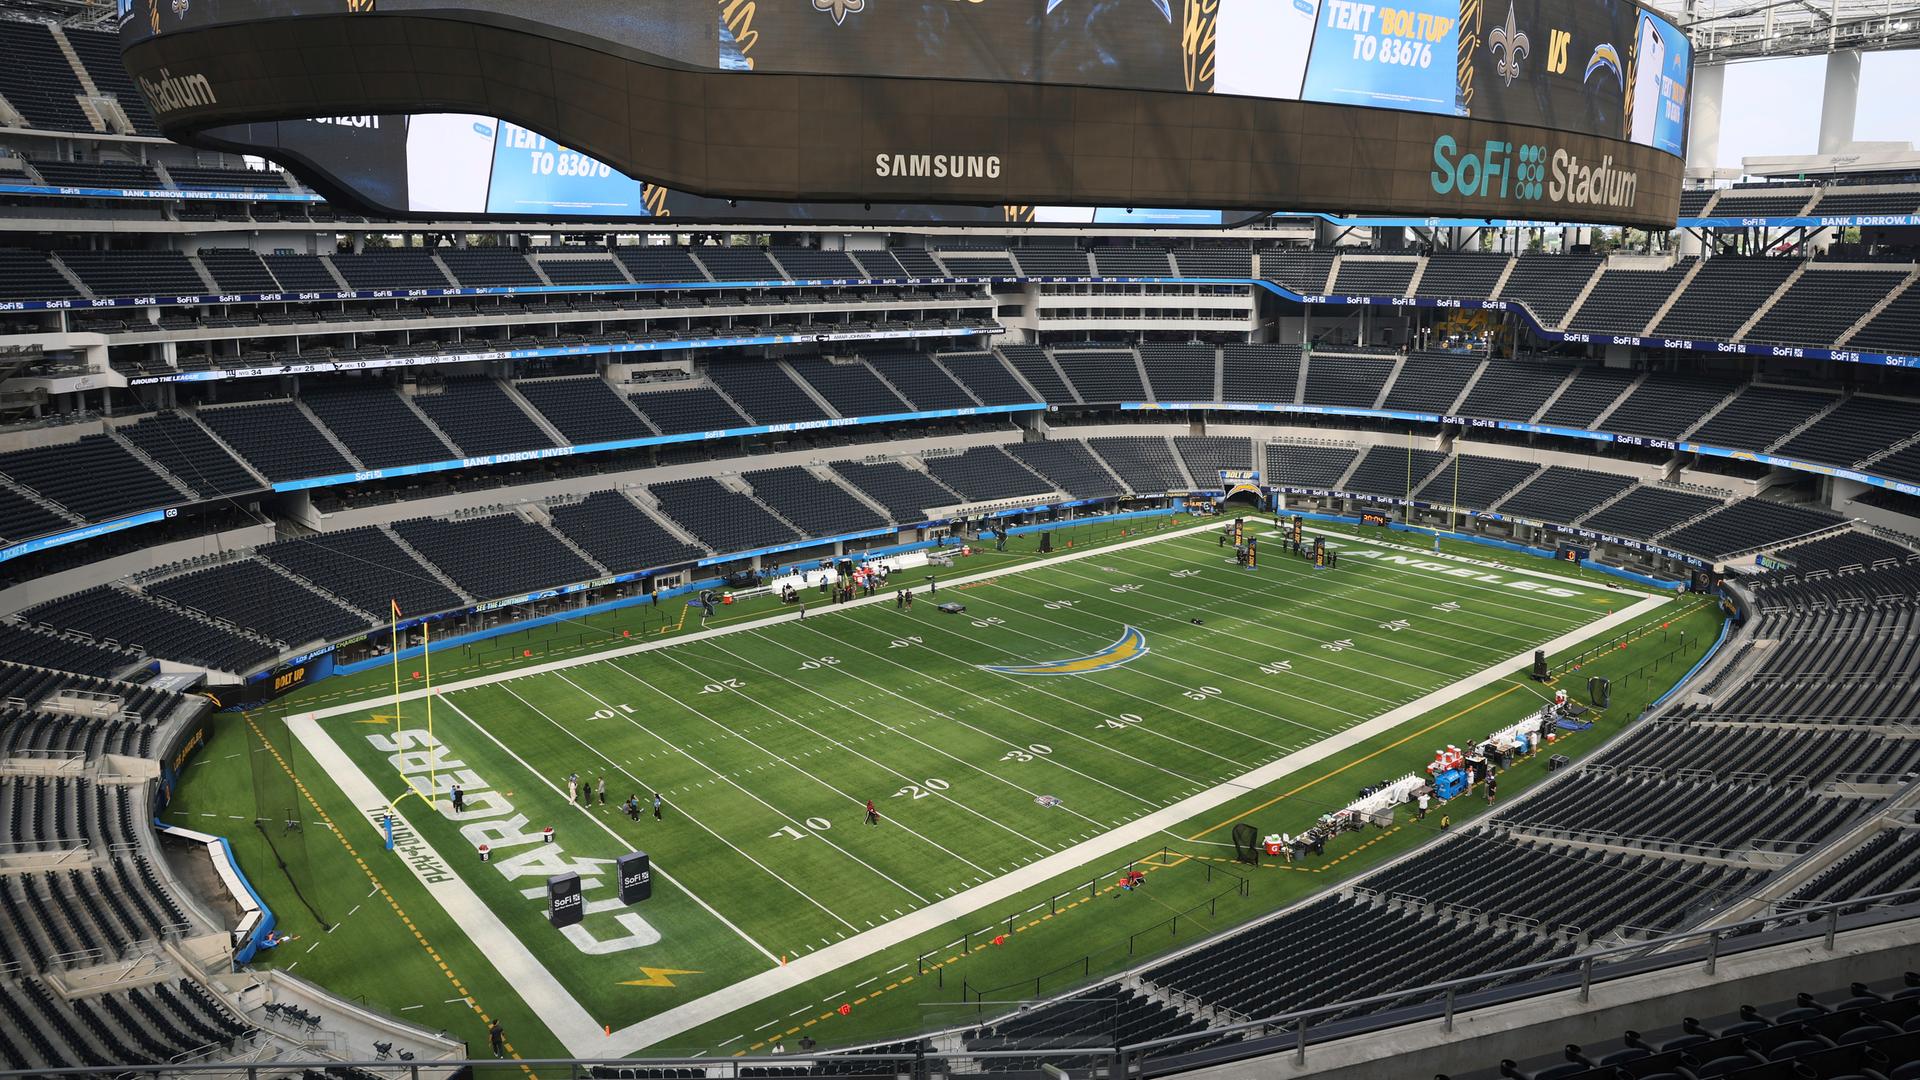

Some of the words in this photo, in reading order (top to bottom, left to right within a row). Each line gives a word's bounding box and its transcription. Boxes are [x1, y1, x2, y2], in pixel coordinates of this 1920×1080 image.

[1327, 0, 1375, 32] TEXT
[1353, 34, 1375, 60] TO
[1380, 36, 1432, 68] 83676
[1547, 30, 1570, 74] VS
[139, 68, 216, 114] Stadium
[531, 152, 554, 175] TO
[876, 154, 1000, 179] SAMSUNG
[1431, 135, 1512, 199] SoFi
[1550, 148, 1637, 208] Stadium
[1822, 217, 1852, 225] BANK.
[1856, 216, 1906, 225] BORROW.
[1564, 334, 1580, 343] SoFi
[1613, 337, 1630, 346] SoFi
[1664, 339, 1683, 349] SoFi
[1718, 343, 1736, 353] SoFi
[1773, 347, 1792, 357] SoFi
[1831, 351, 1850, 361] SoFi
[1886, 356, 1905, 367] SoFi
[795, 420, 829, 429] BORROW.
[832, 418, 858, 426] INVEST.
[1617, 436, 1633, 444] SoFi
[1650, 440, 1666, 448] SoFi
[464, 456, 492, 467] BANK.
[496, 450, 539, 463] BORROW.
[542, 447, 575, 458] INVEST.
[355, 472, 373, 481] SoFi
[1338, 550, 1584, 598] ANGELES
[476, 604, 486, 612] SEE
[1432, 602, 1460, 612] 10
[971, 616, 1006, 628] 50
[1379, 620, 1410, 631] 20
[893, 635, 924, 648] 40
[1321, 640, 1354, 652] 30
[296, 655, 307, 664] LOS
[308, 645, 335, 660] ANGELES
[336, 635, 367, 648] CHARGERS
[802, 655, 841, 670] 30
[1259, 661, 1292, 675] 40
[275, 671, 293, 690] BOLT
[294, 668, 304, 680] UP
[704, 678, 746, 694] 20
[1182, 686, 1222, 700] 50
[593, 703, 639, 720] 10
[1105, 713, 1143, 730] 40
[1006, 744, 1052, 762] 30
[898, 778, 950, 799] 20
[783, 817, 831, 841] 10
[364, 729, 662, 955] CHARGERS
[625, 874, 640, 885] SoFi
[554, 896, 571, 908] SoFi
